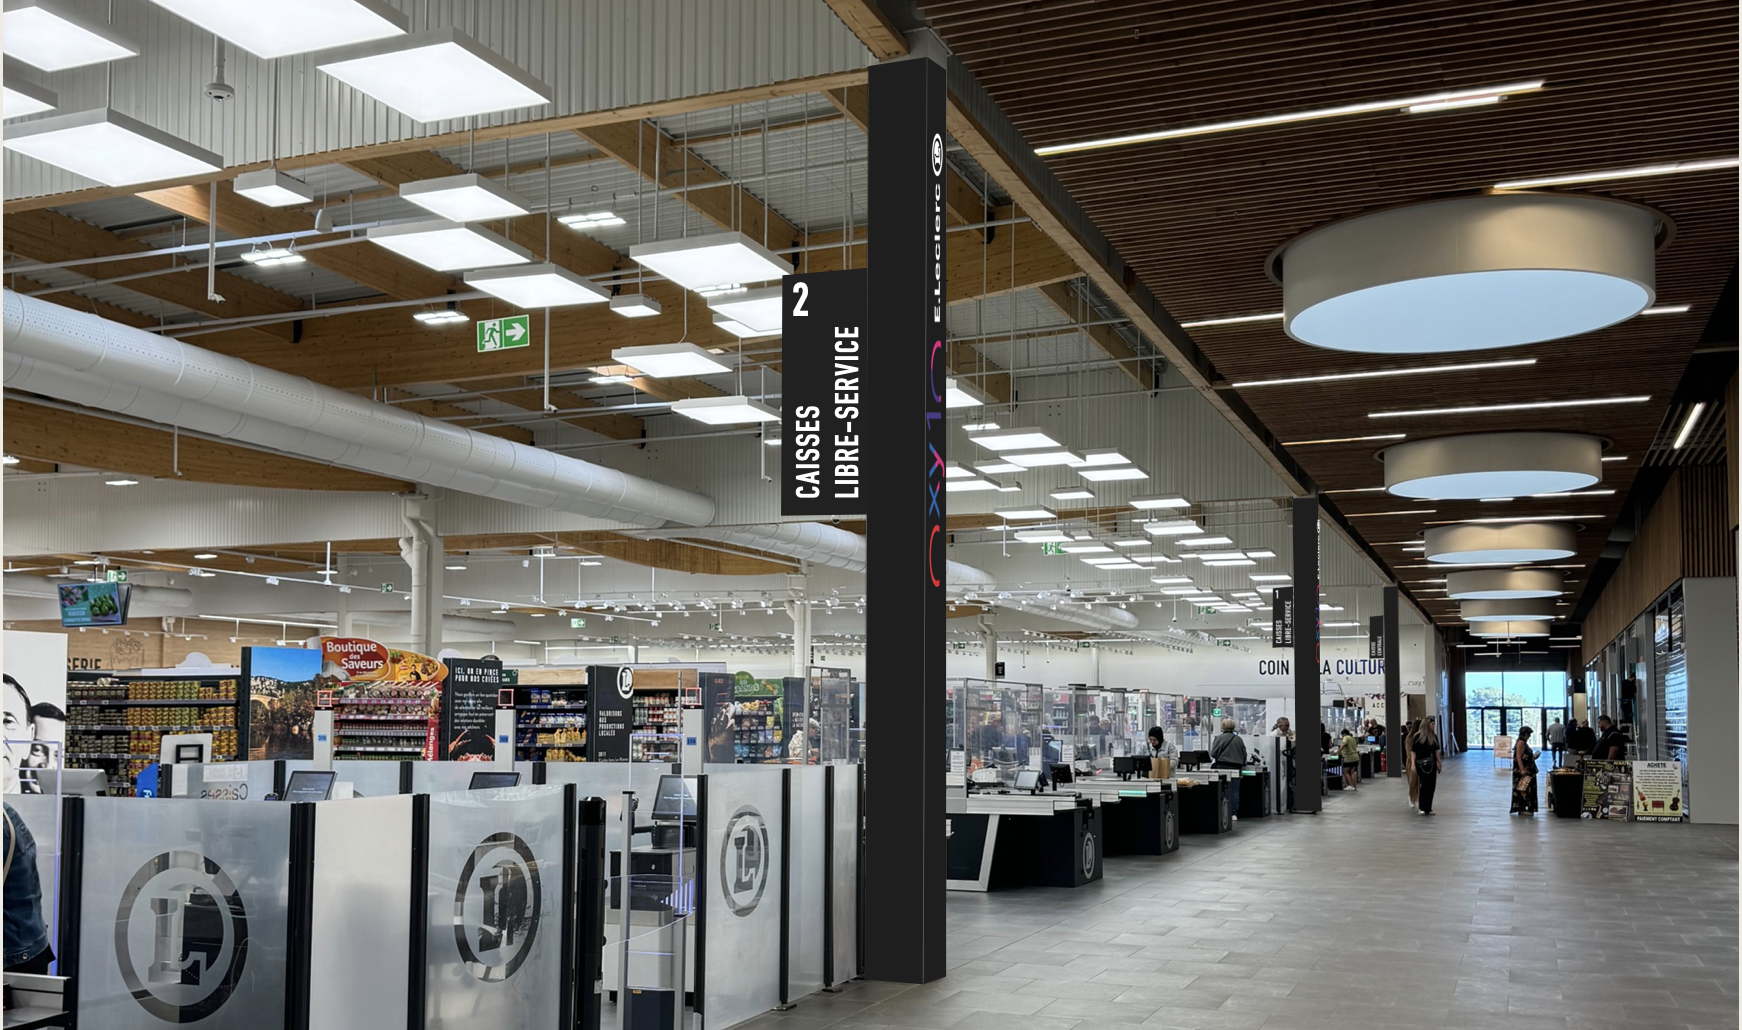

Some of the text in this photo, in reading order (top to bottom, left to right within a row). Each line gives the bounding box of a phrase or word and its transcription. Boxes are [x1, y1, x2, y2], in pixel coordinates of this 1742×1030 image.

[792, 281, 809, 317] 2
[834, 326, 860, 499] LIBRE-SERVICE
[795, 404, 820, 499] CAISSES
[1275, 590, 1279, 599] 1
[1284, 600, 1292, 644] LIBRE-SERVICE
[326, 641, 376, 655] Boutique
[341, 658, 384, 670] Saveurs
[1259, 660, 1290, 675] COIN
[454, 674, 468, 682] POUR
[484, 668, 499, 676] PINCE
